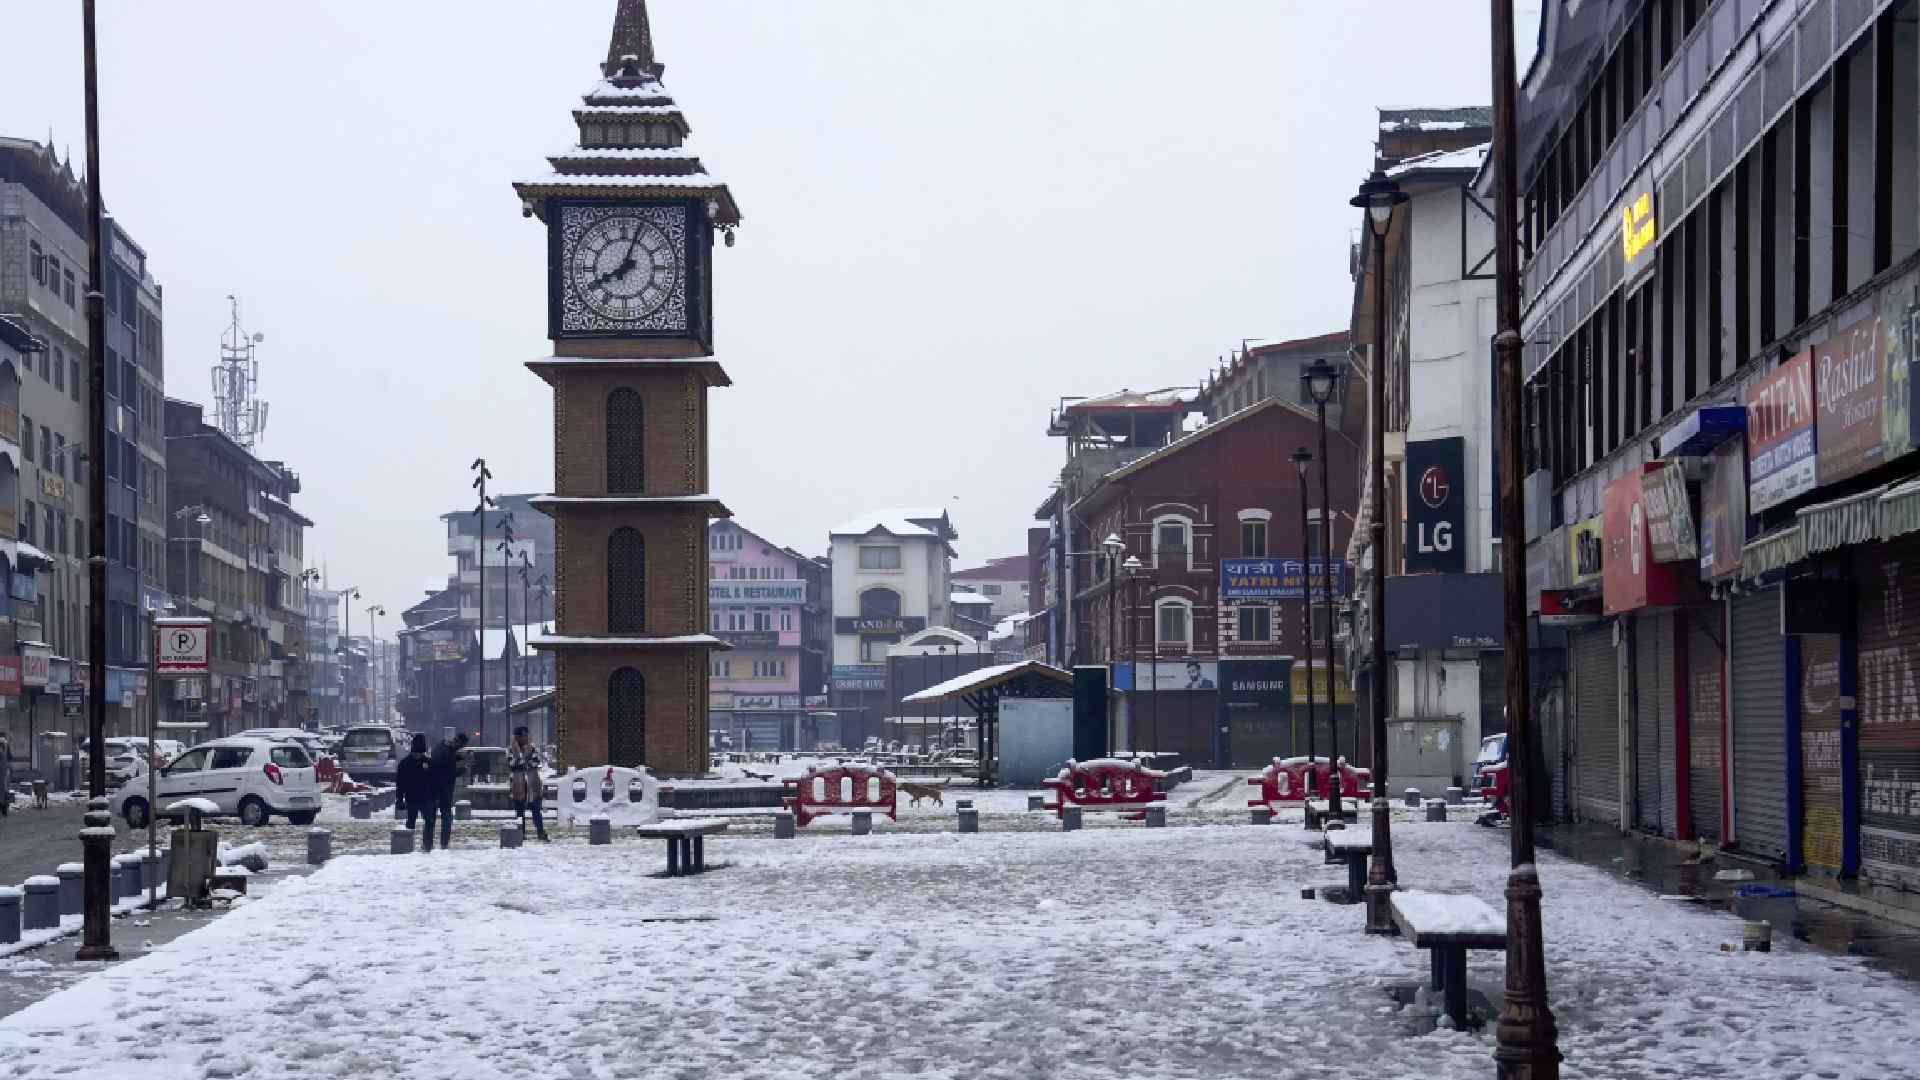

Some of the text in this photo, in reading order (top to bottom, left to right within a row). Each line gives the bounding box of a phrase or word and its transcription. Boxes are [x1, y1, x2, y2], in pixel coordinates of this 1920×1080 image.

[1759, 360, 1812, 440] TITAN
[1418, 520, 1452, 553] LG
[744, 587, 802, 599] RESTAURANT
[1232, 680, 1284, 691] SAMSUNG
